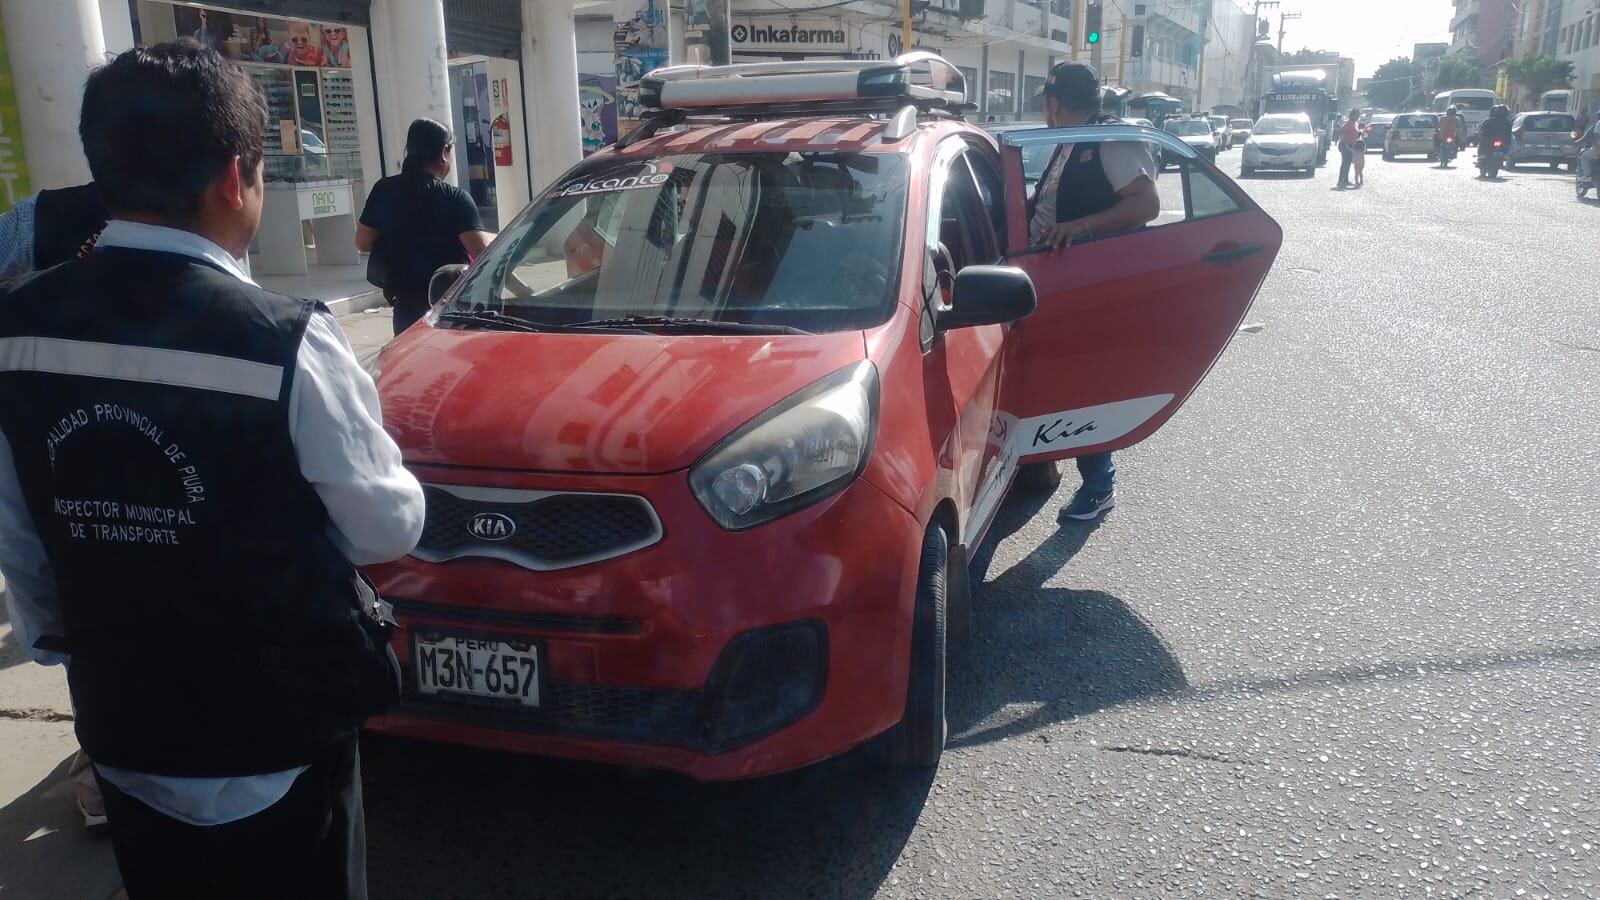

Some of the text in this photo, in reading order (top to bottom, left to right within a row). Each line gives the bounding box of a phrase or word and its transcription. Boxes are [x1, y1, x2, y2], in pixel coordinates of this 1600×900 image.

[750, 25, 845, 43] Inkafarma
[561, 174, 669, 196] picanto
[1031, 418, 1098, 447] Kia
[94, 403, 164, 445] PROVINCIAL
[163, 443, 188, 464] DE
[177, 465, 205, 504] PIURA
[54, 497, 197, 525] NSPECTOR MUNICIPAL
[70, 522, 180, 545] DE TRANSPORTE
[473, 518, 507, 536] KIA
[420, 647, 536, 697] M3N-657
